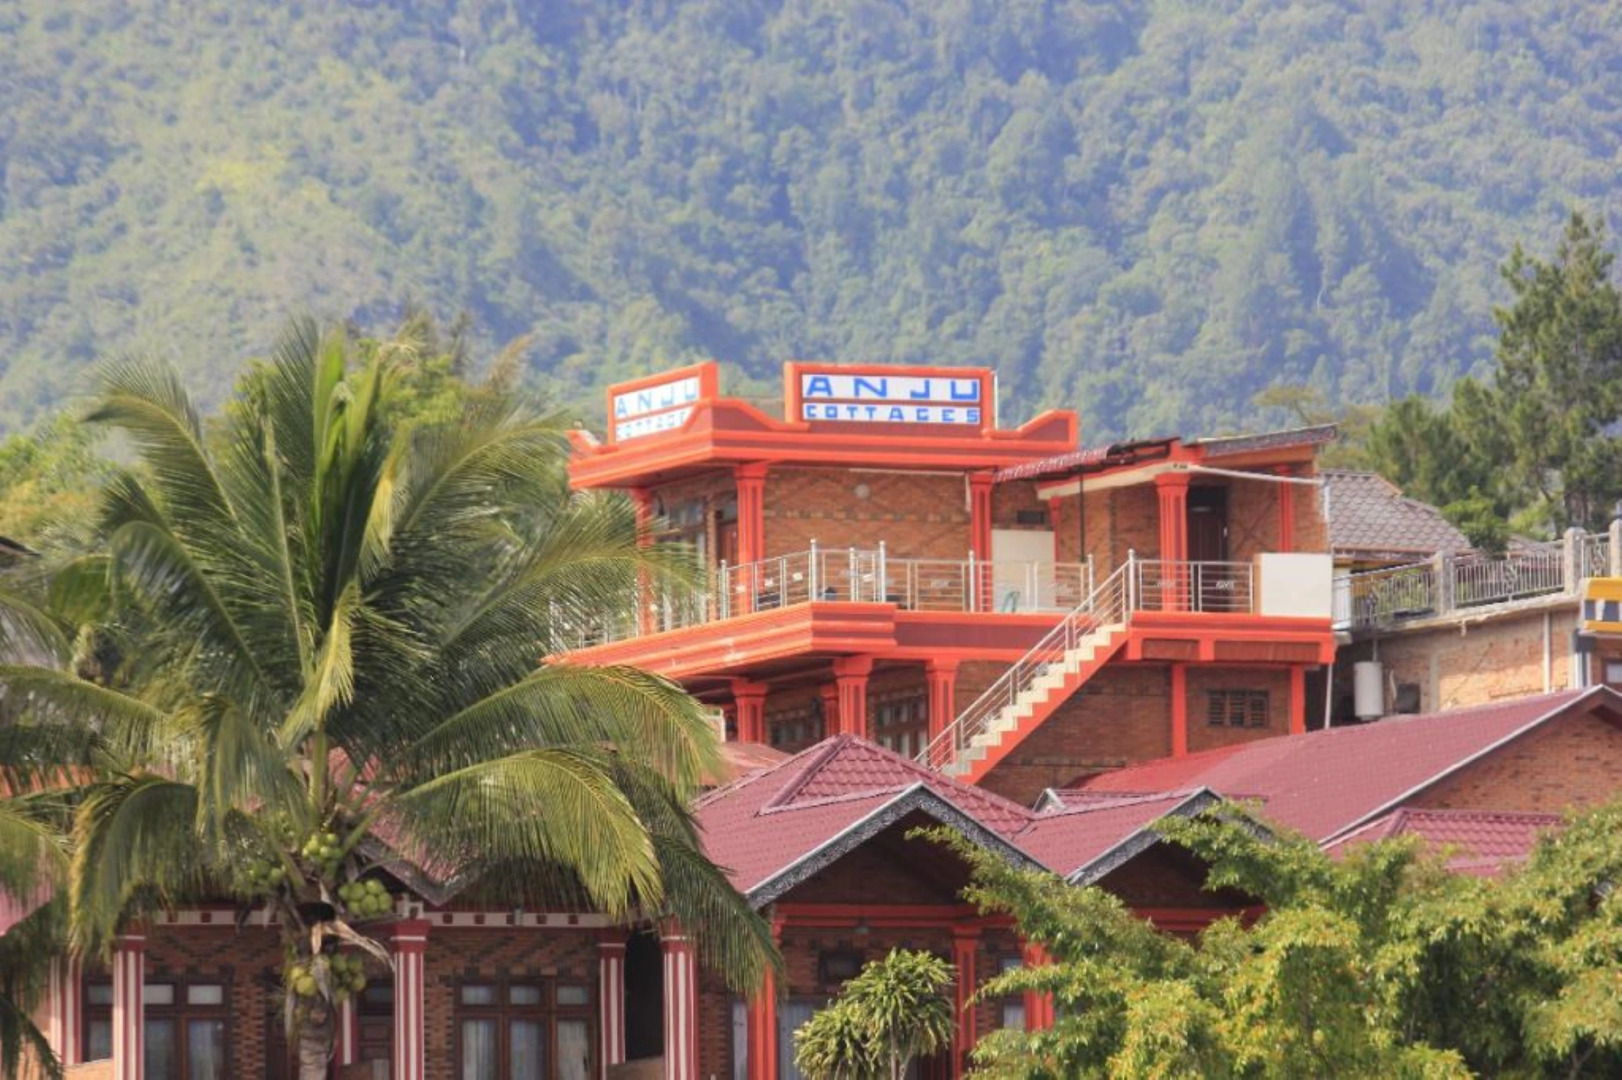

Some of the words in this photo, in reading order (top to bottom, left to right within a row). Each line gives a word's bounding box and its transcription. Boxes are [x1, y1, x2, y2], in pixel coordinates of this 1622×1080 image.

[616, 379, 698, 417] ANJU
[806, 376, 979, 400] ANJU
[806, 405, 980, 423] COTTAGES
